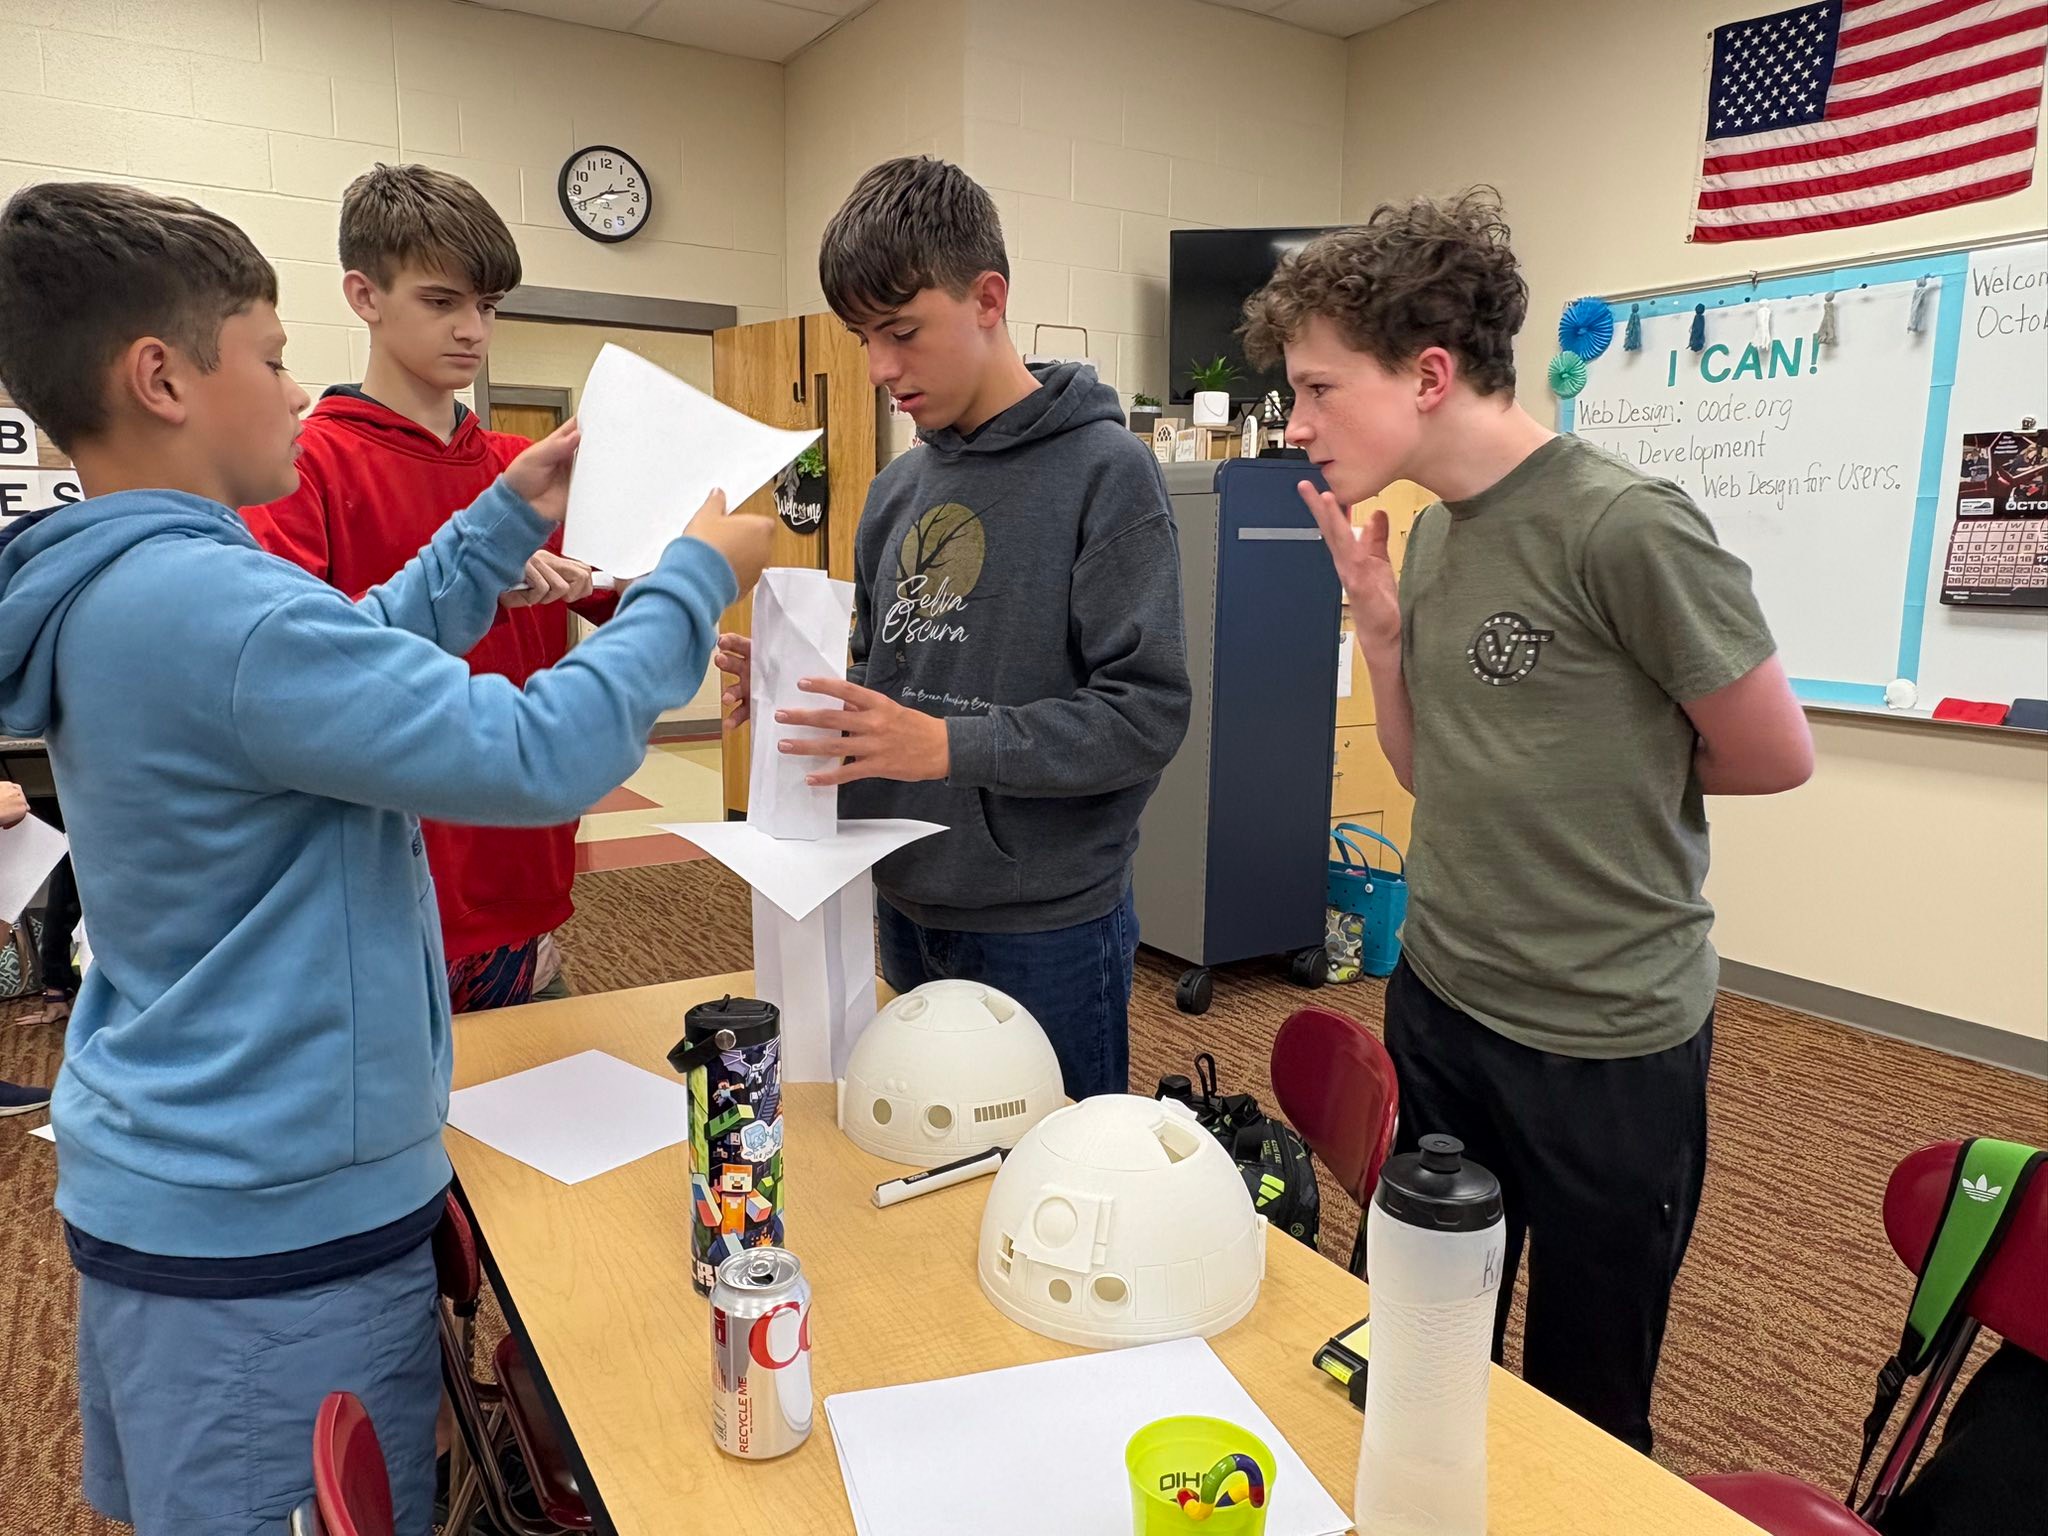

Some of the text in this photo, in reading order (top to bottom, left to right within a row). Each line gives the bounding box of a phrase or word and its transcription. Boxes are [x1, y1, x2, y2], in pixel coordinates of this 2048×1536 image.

[587, 160, 596, 171] 11
[600, 158, 613, 170] 12
[619, 165, 623, 175] 1
[576, 170, 589, 182] 10
[627, 177, 636, 188] 2
[573, 184, 582, 195] 9
[631, 192, 640, 203] 3
[578, 200, 588, 211] 8
[589, 212, 597, 223] 7
[627, 207, 636, 217] 4
[603, 218, 612, 229] 6
[616, 216, 625, 226] 5
[1667, 333, 1820, 388] I CAN!
[1579, 394, 1793, 433] Web Design: code.org
[1638, 430, 1767, 474] Development
[1703, 462, 1901, 510] Web Design for Users.
[896, 575, 969, 617] Selva
[882, 600, 970, 643] Oscura
[737, 1376, 749, 1454] RECYCLE ME
